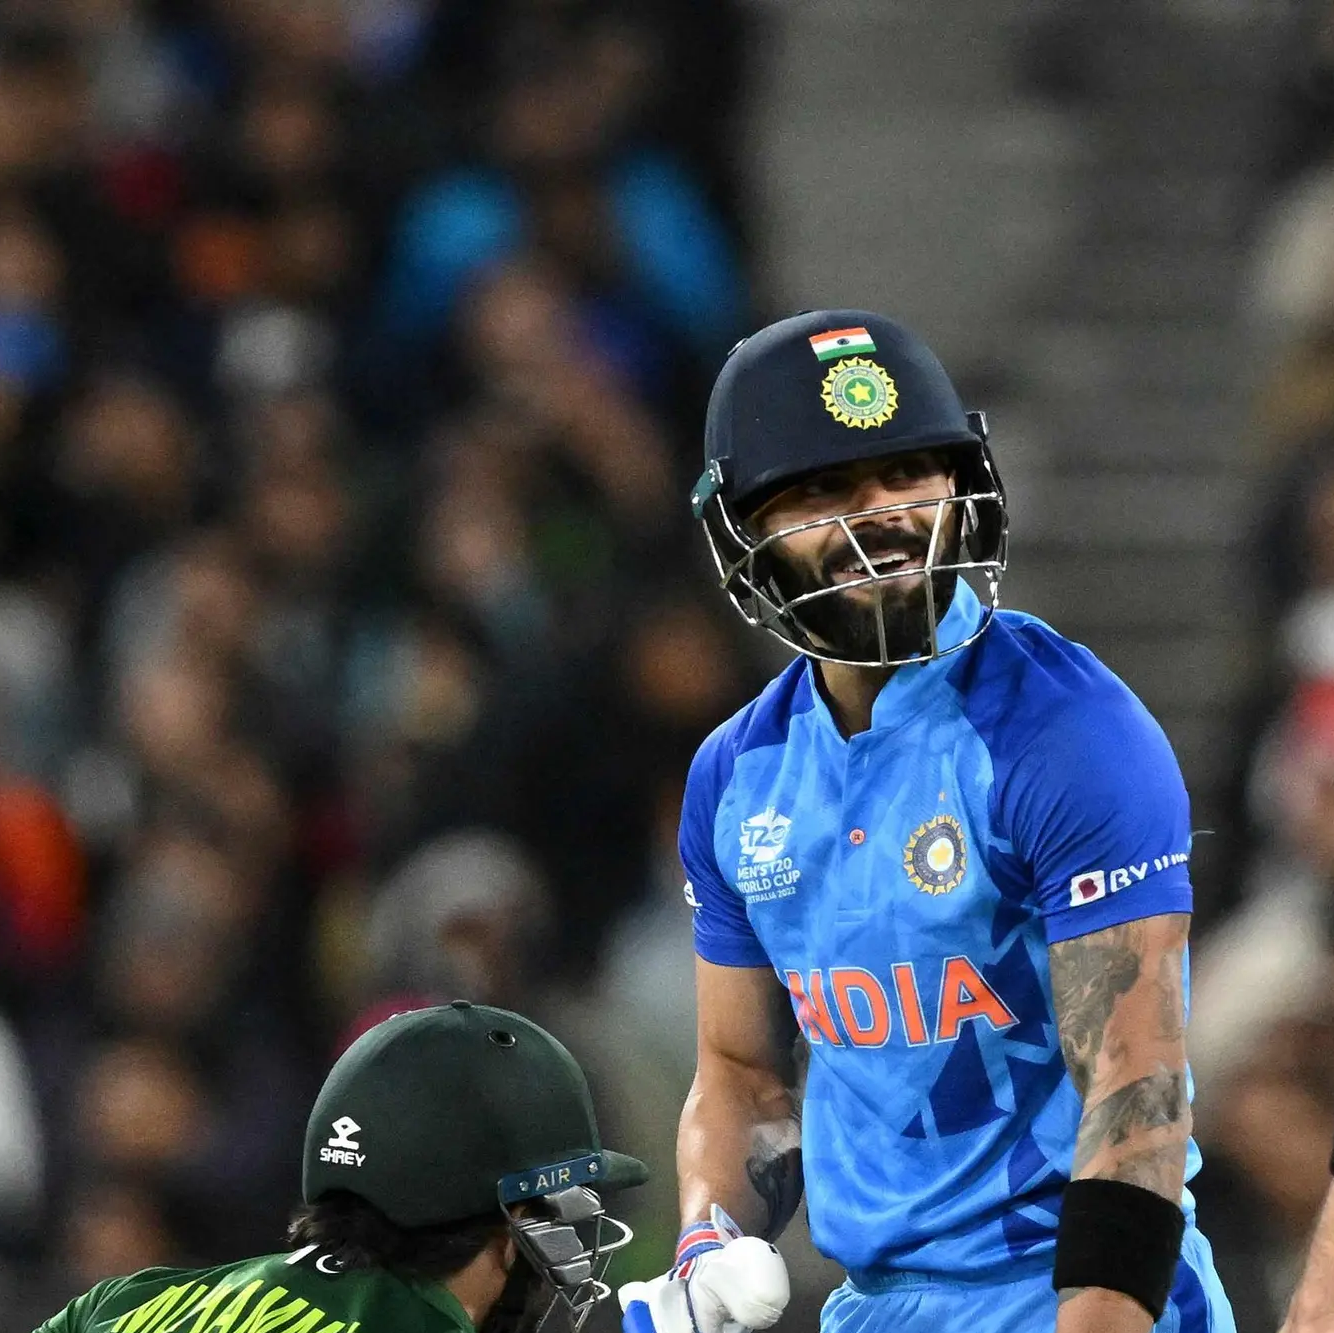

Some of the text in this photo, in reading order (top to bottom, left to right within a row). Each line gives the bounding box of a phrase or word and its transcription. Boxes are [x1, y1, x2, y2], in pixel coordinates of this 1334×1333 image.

[771, 858, 793, 875] T20
[736, 870, 801, 893] WORLD CUP
[774, 954, 1020, 1049] NDIA
[319, 1148, 366, 1168] SHREY
[535, 1167, 571, 1191] AIR
